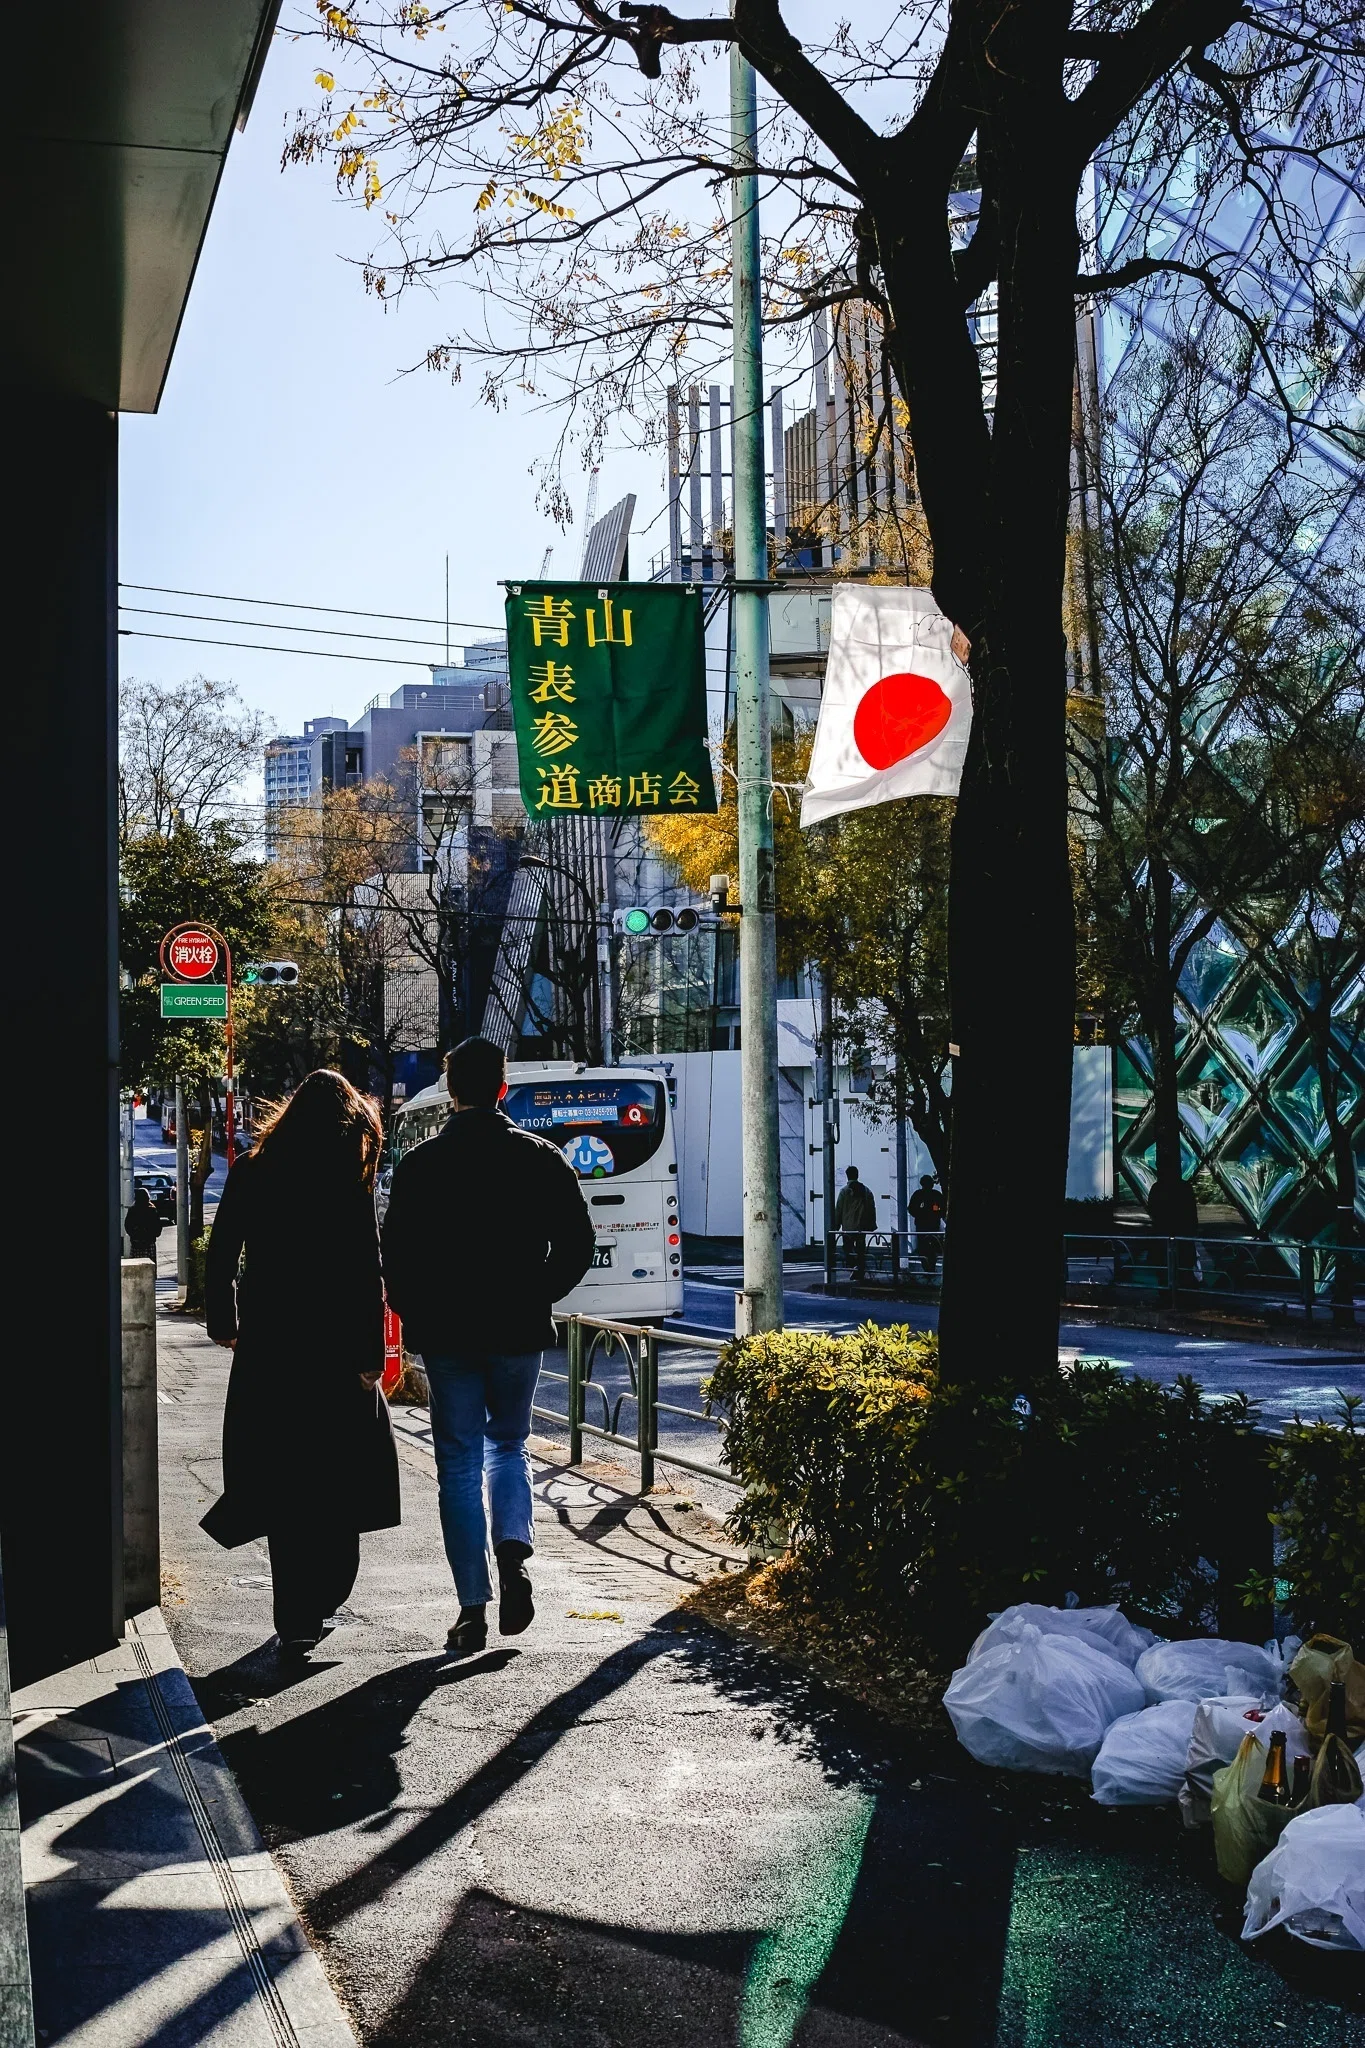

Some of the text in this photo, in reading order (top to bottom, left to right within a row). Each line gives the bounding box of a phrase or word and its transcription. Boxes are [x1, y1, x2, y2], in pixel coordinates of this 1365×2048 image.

[524, 595, 632, 648] 青山
[586, 770, 700, 809] 商店会
[175, 945, 214, 964] 消火栓
[174, 997, 225, 1006] GREEN SEED
[520, 1118, 552, 1127] T1076
[629, 1108, 641, 1122] Q
